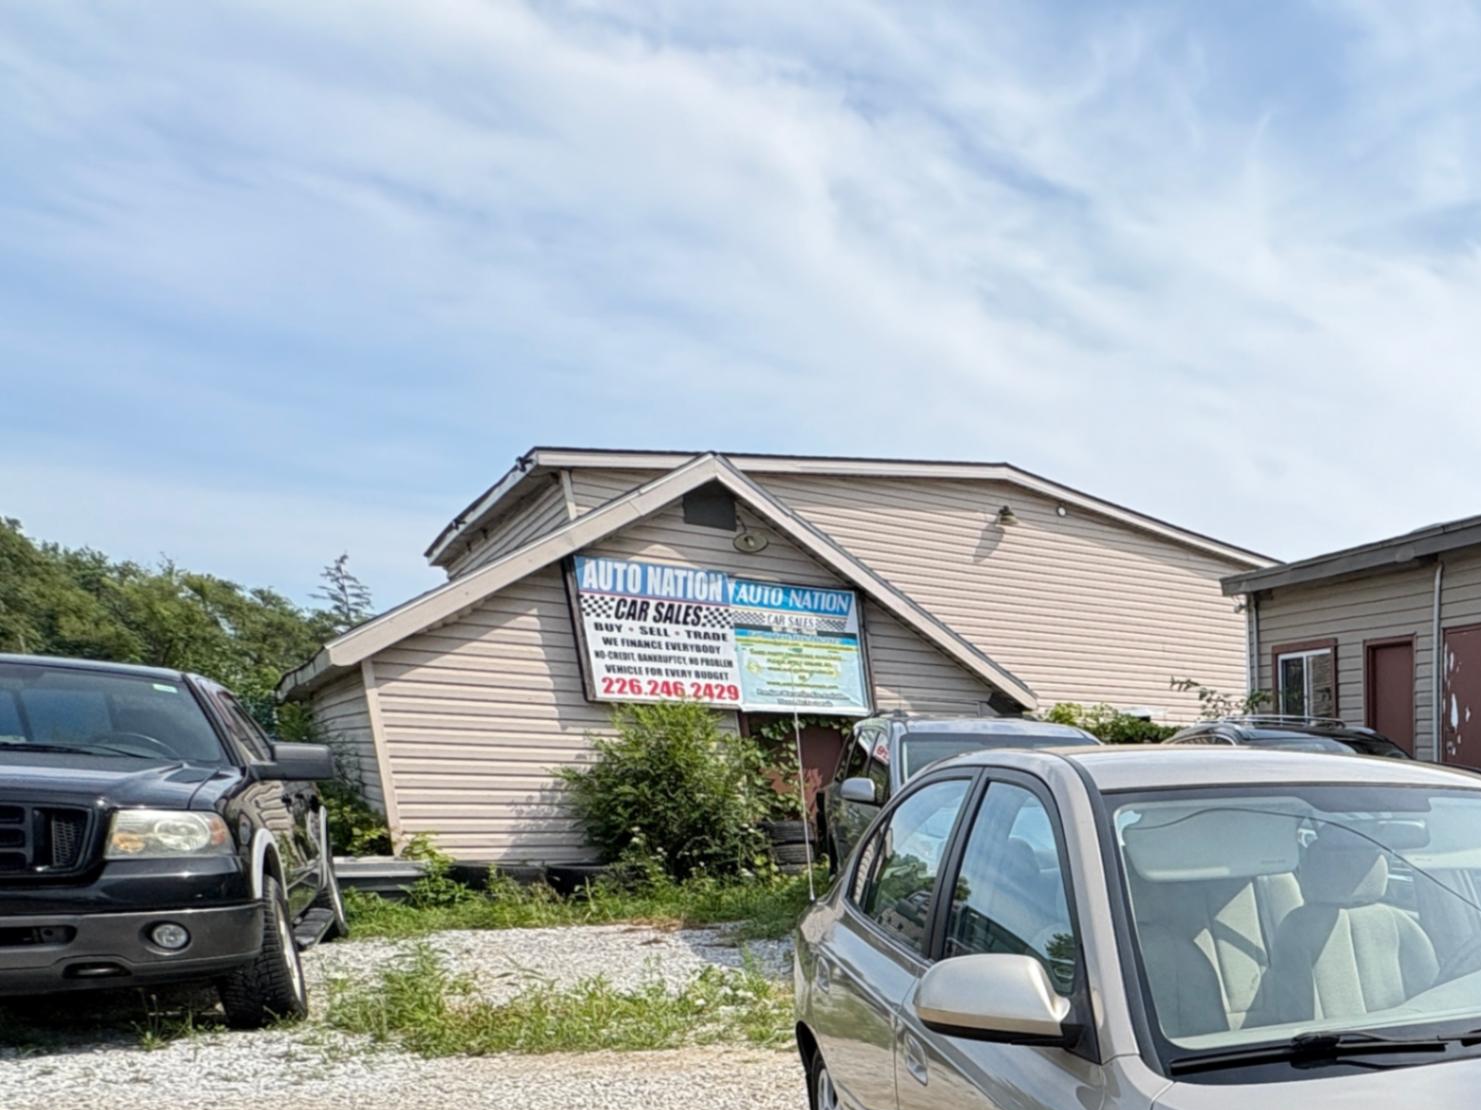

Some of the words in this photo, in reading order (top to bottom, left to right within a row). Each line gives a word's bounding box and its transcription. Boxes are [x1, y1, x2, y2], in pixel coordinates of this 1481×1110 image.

[583, 559, 642, 593] AUTO
[647, 566, 723, 602] NATION
[736, 583, 783, 606] AUTO
[789, 589, 849, 613] NATION
[614, 598, 650, 622] CAR
[653, 602, 703, 627] SALES
[594, 622, 622, 633] BUY
[640, 626, 671, 637] SELL
[685, 630, 728, 642] TRADE
[602, 637, 618, 647] WE
[621, 638, 662, 650] FINANCE
[665, 641, 721, 654] EVERYBODY
[605, 664, 643, 675] VEHICLE
[645, 666, 662, 676] FOR
[665, 667, 692, 679] EVERY
[602, 677, 740, 700] 226.246.2429
